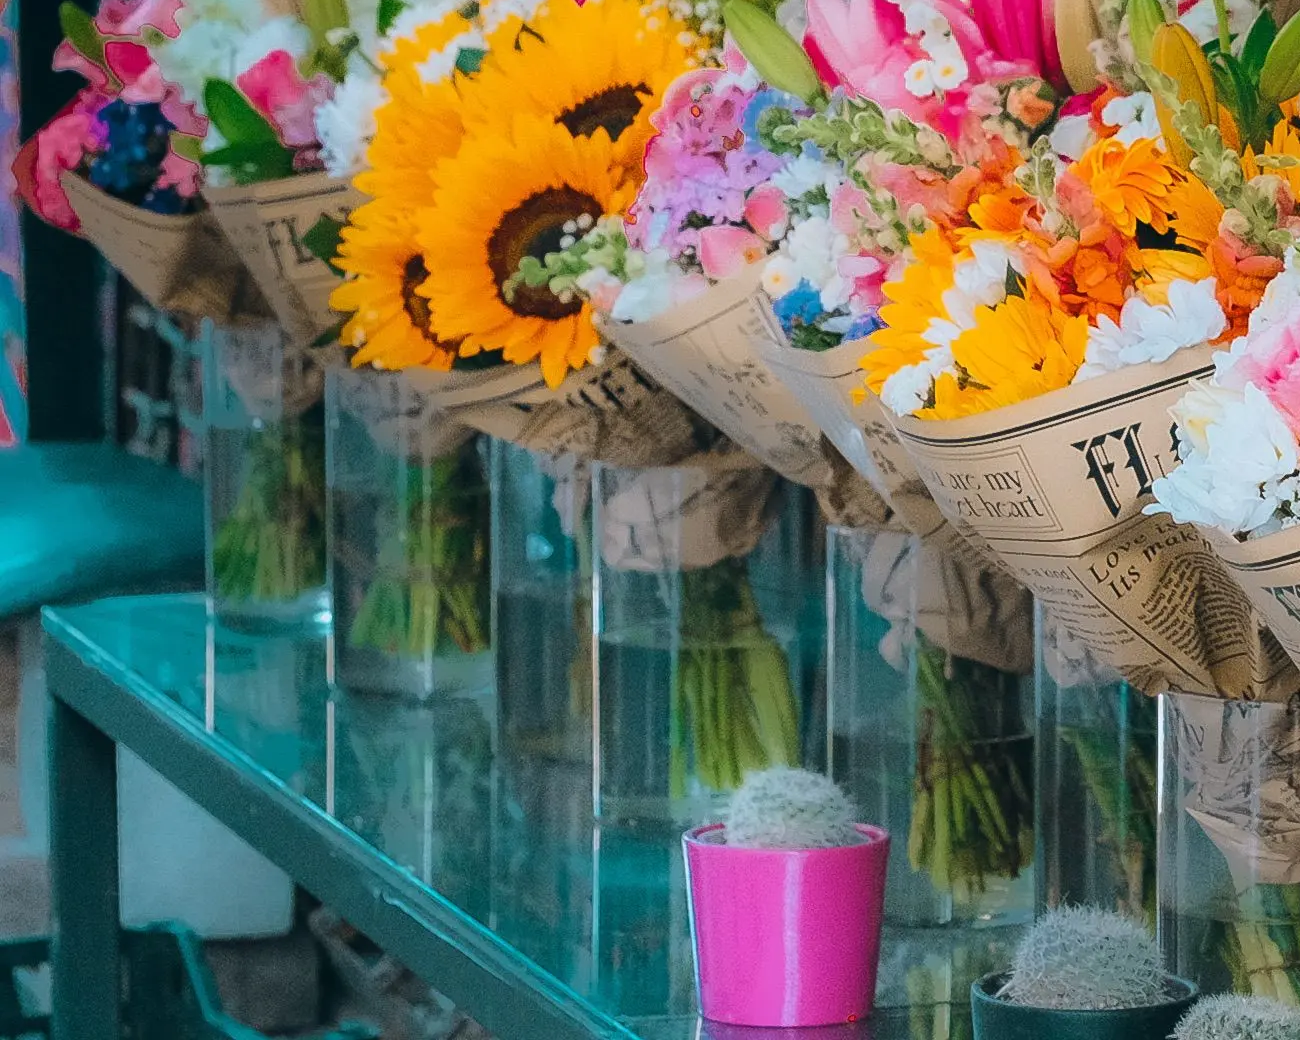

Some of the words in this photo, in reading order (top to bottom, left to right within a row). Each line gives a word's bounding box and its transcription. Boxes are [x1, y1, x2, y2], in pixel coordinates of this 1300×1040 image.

[983, 469, 1024, 495] my
[1088, 532, 1147, 585] Love
[1108, 564, 1142, 601] Its
